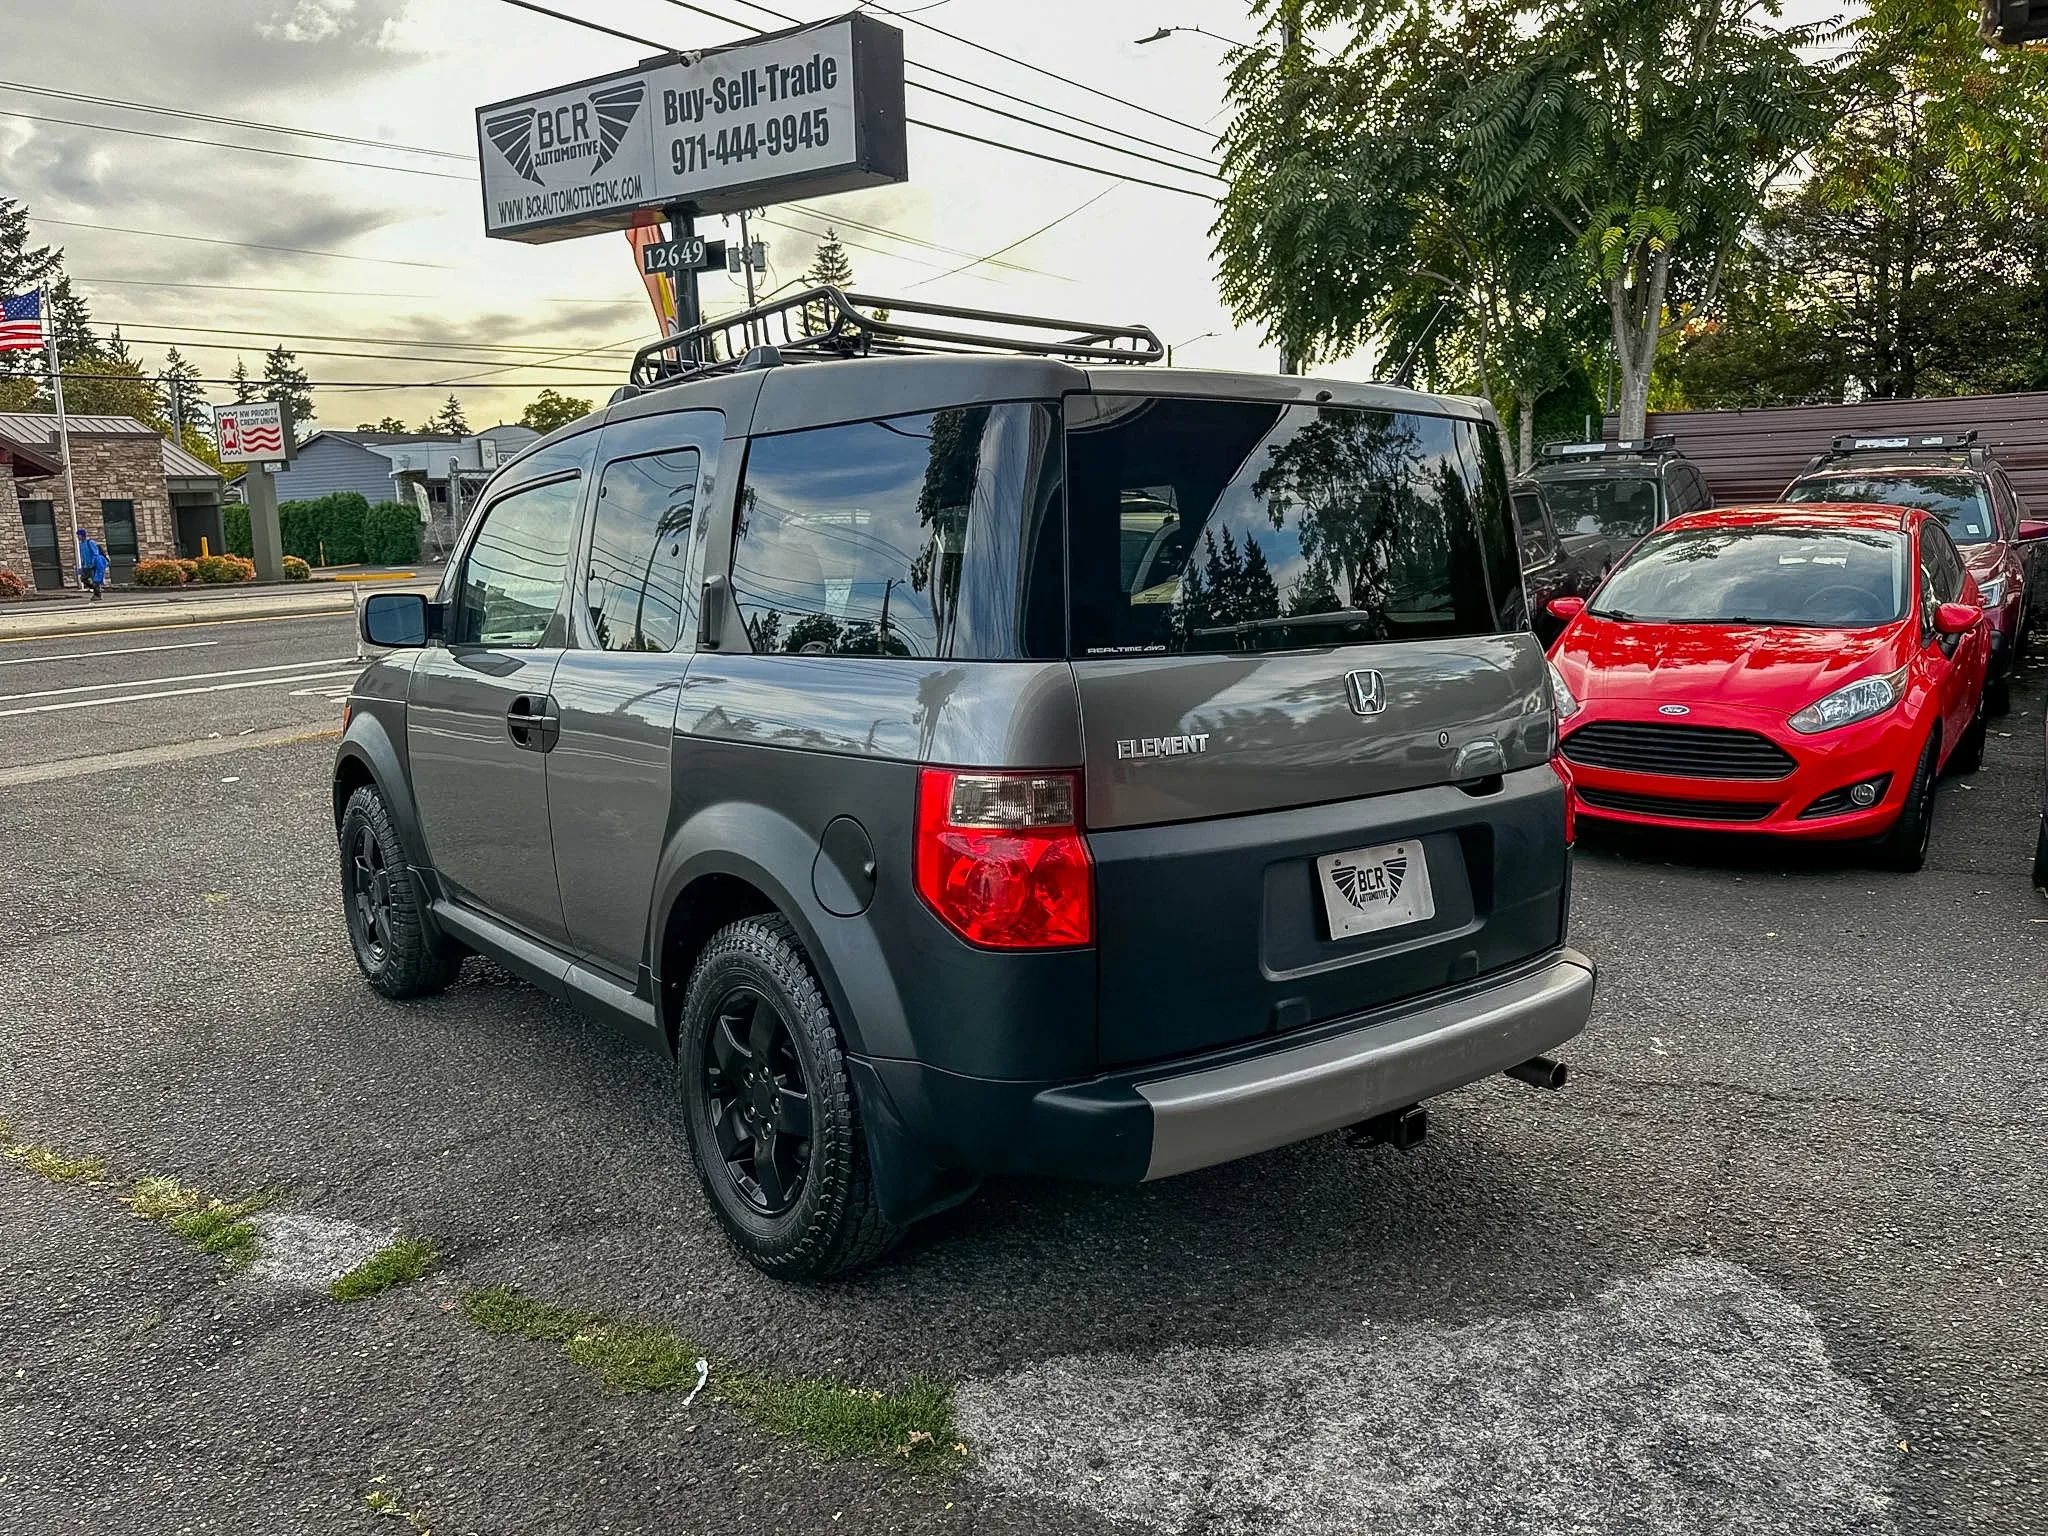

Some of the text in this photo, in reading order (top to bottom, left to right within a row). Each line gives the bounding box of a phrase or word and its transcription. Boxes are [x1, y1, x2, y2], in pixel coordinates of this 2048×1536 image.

[663, 53, 838, 126] Buy-Sell-Trade
[537, 102, 590, 149] BCR
[534, 140, 599, 167] AUTOMOTIVE
[671, 107, 830, 176] 971-444-9945
[498, 174, 644, 224] WWW.BCRAUTOMOTIVEINC.COM
[645, 240, 704, 270] 12649
[239, 407, 278, 418] NW PRIORITY
[240, 417, 279, 426] CREDIT UNION
[1116, 733, 1210, 760] ELEMENT
[1357, 866, 1386, 892] BCR
[1359, 888, 1390, 903] AUTOMOTIVE
